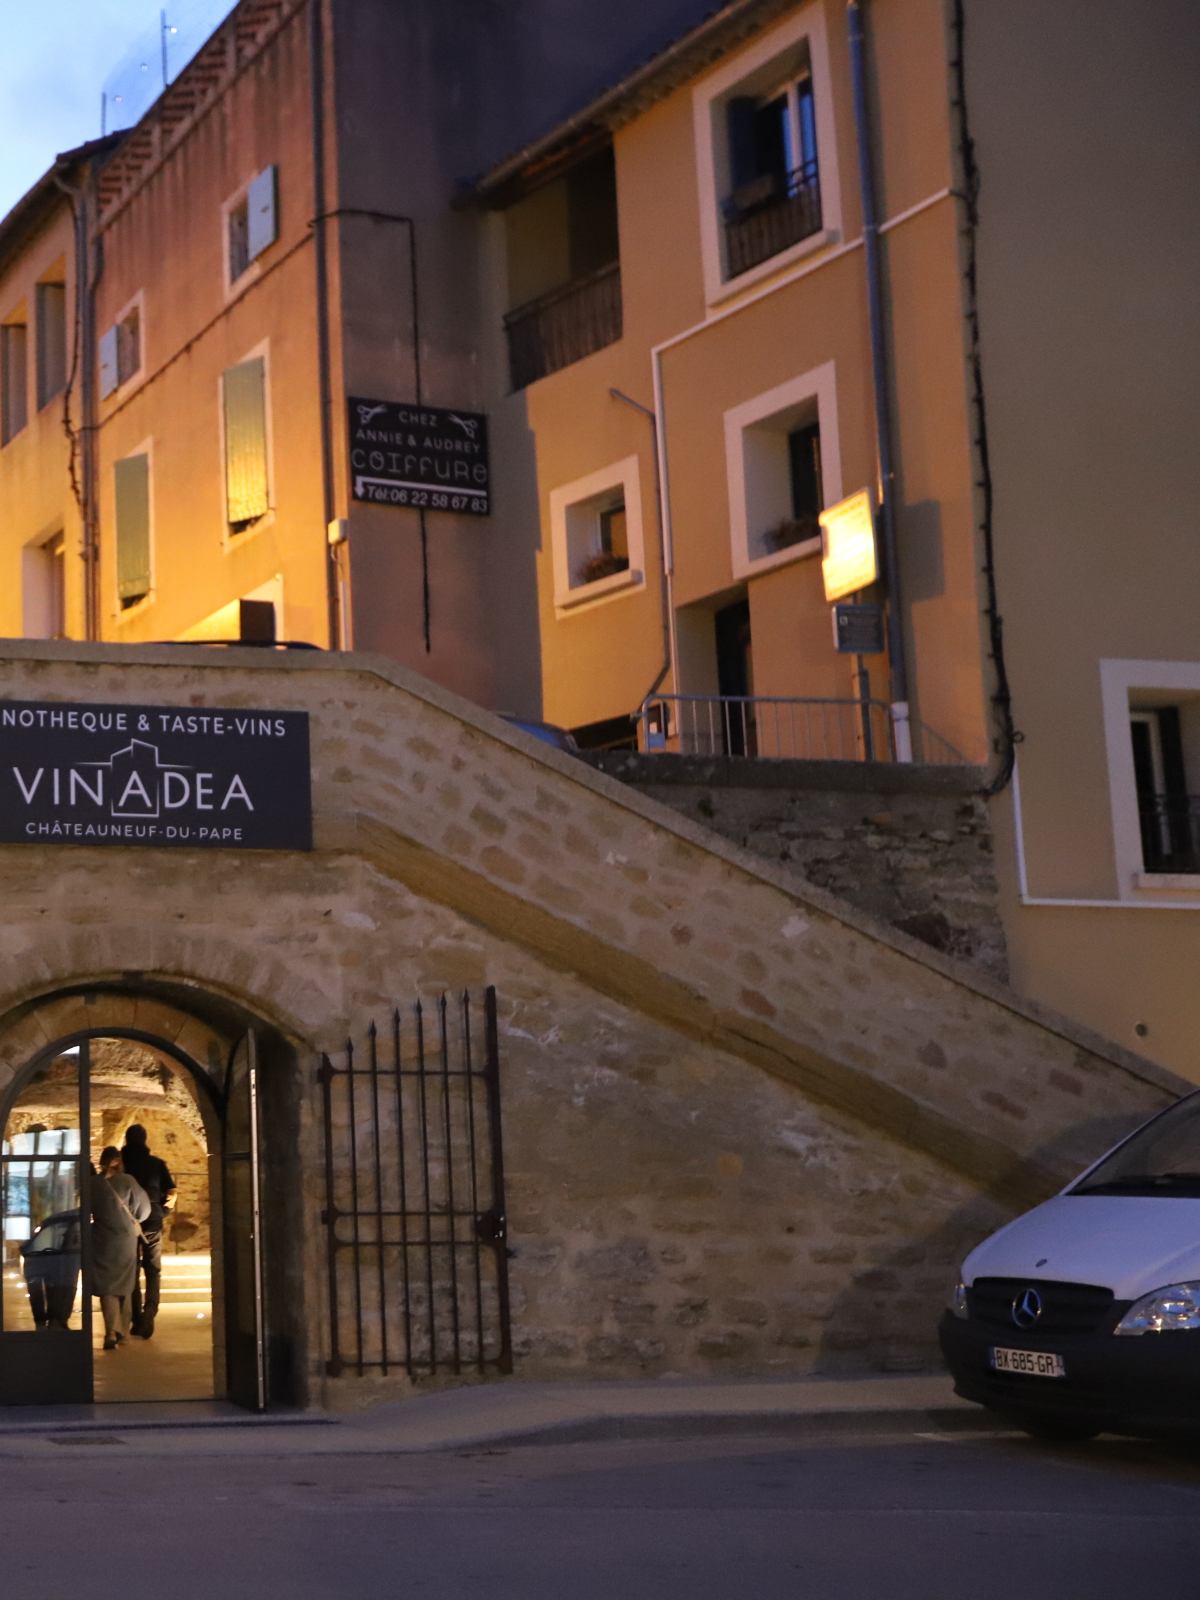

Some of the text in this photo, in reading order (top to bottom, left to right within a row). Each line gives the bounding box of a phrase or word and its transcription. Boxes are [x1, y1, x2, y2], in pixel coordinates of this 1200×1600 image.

[399, 411, 437, 427] CHEZ
[356, 429, 480, 453] ANNIE & AUDREY
[412, 491, 428, 506] 22
[452, 497, 468, 510] 67
[472, 499, 488, 513] 83
[138, 715, 150, 731] &
[159, 715, 286, 737] TASTE-VINS
[13, 767, 254, 812] VINADEA
[25, 820, 243, 840] CHÂTEAUNEUF-DU-PAPE
[996, 1350, 1055, 1374] BX-685-GR
